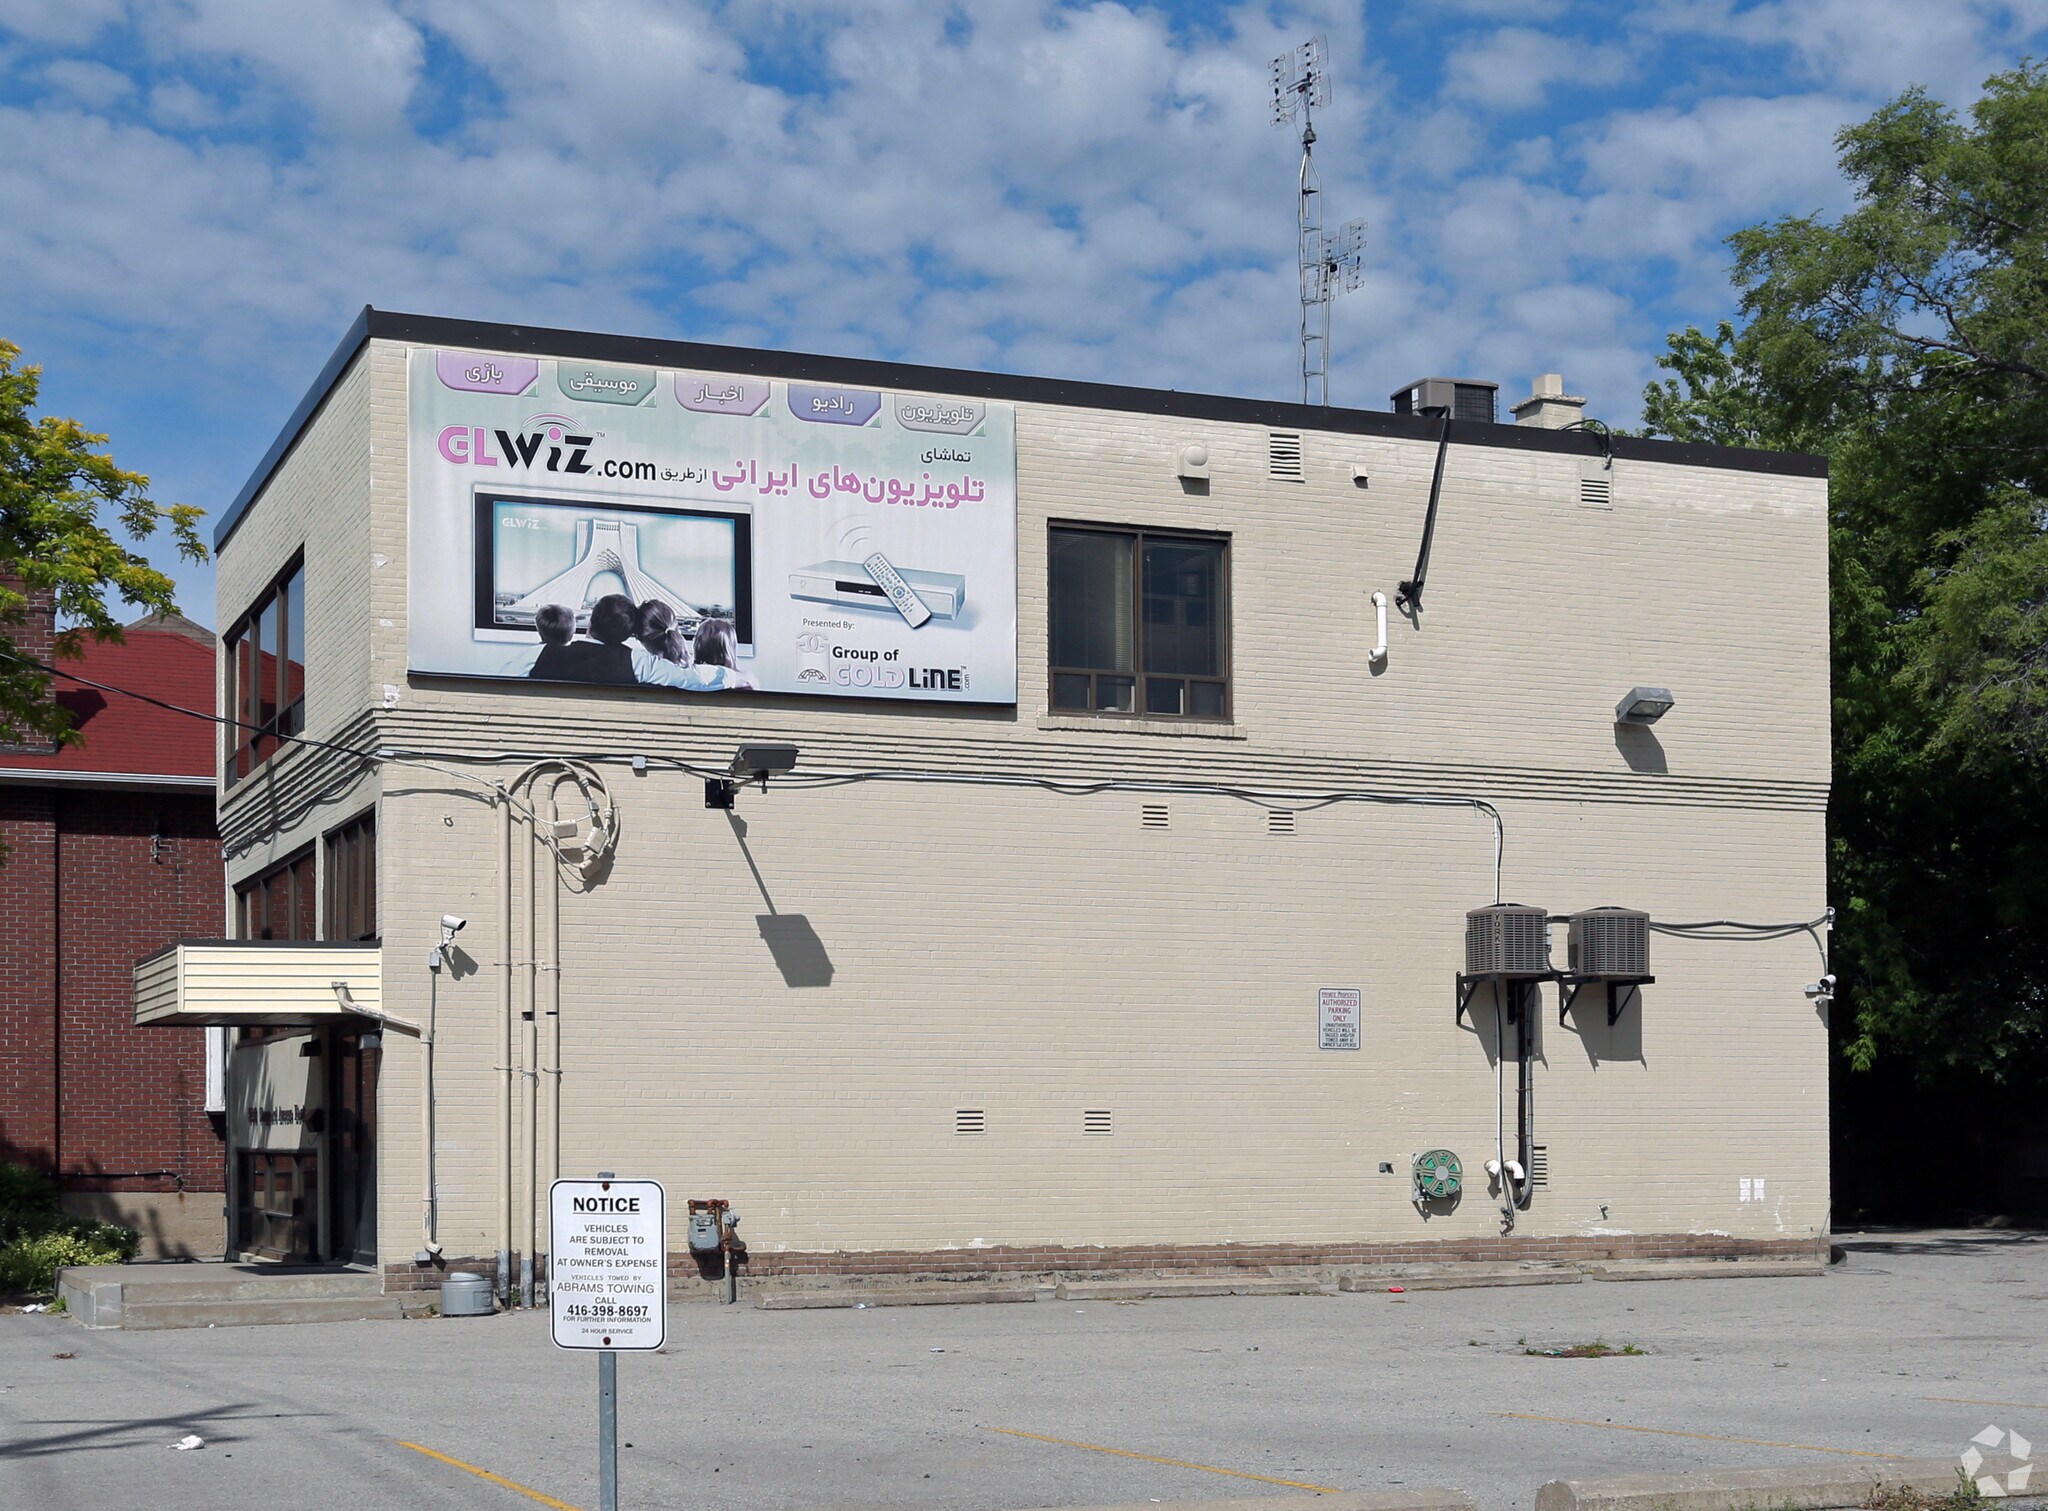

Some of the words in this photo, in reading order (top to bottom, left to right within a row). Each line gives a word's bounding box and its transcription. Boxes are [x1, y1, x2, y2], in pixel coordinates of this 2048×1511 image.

[465, 363, 503, 383] بازی
[569, 372, 638, 392] موسیقی
[811, 396, 854, 415] رادیو
[901, 402, 974, 424] تلویزیون
[920, 447, 971, 464] تماشای
[711, 459, 798, 496] ایرانی
[802, 618, 842, 629] Presented
[843, 620, 855, 630] By:
[832, 646, 879, 662] Group
[883, 649, 899, 661] of
[573, 1197, 640, 1212] NOTICE
[584, 1224, 629, 1233] VEHICLES
[569, 1235, 588, 1244] ARE
[589, 1236, 630, 1245] SUBJECT
[632, 1236, 645, 1245] TO
[584, 1247, 629, 1256] REMOVAL
[557, 1258, 568, 1266] AT
[569, 1258, 613, 1267] OWNER'S
[615, 1259, 659, 1268] EXPENSE
[556, 1282, 604, 1293] ABRAMS
[607, 1284, 655, 1294] TOWING
[594, 1296, 617, 1304] CALL
[567, 1305, 649, 1317] 416-398-8697
